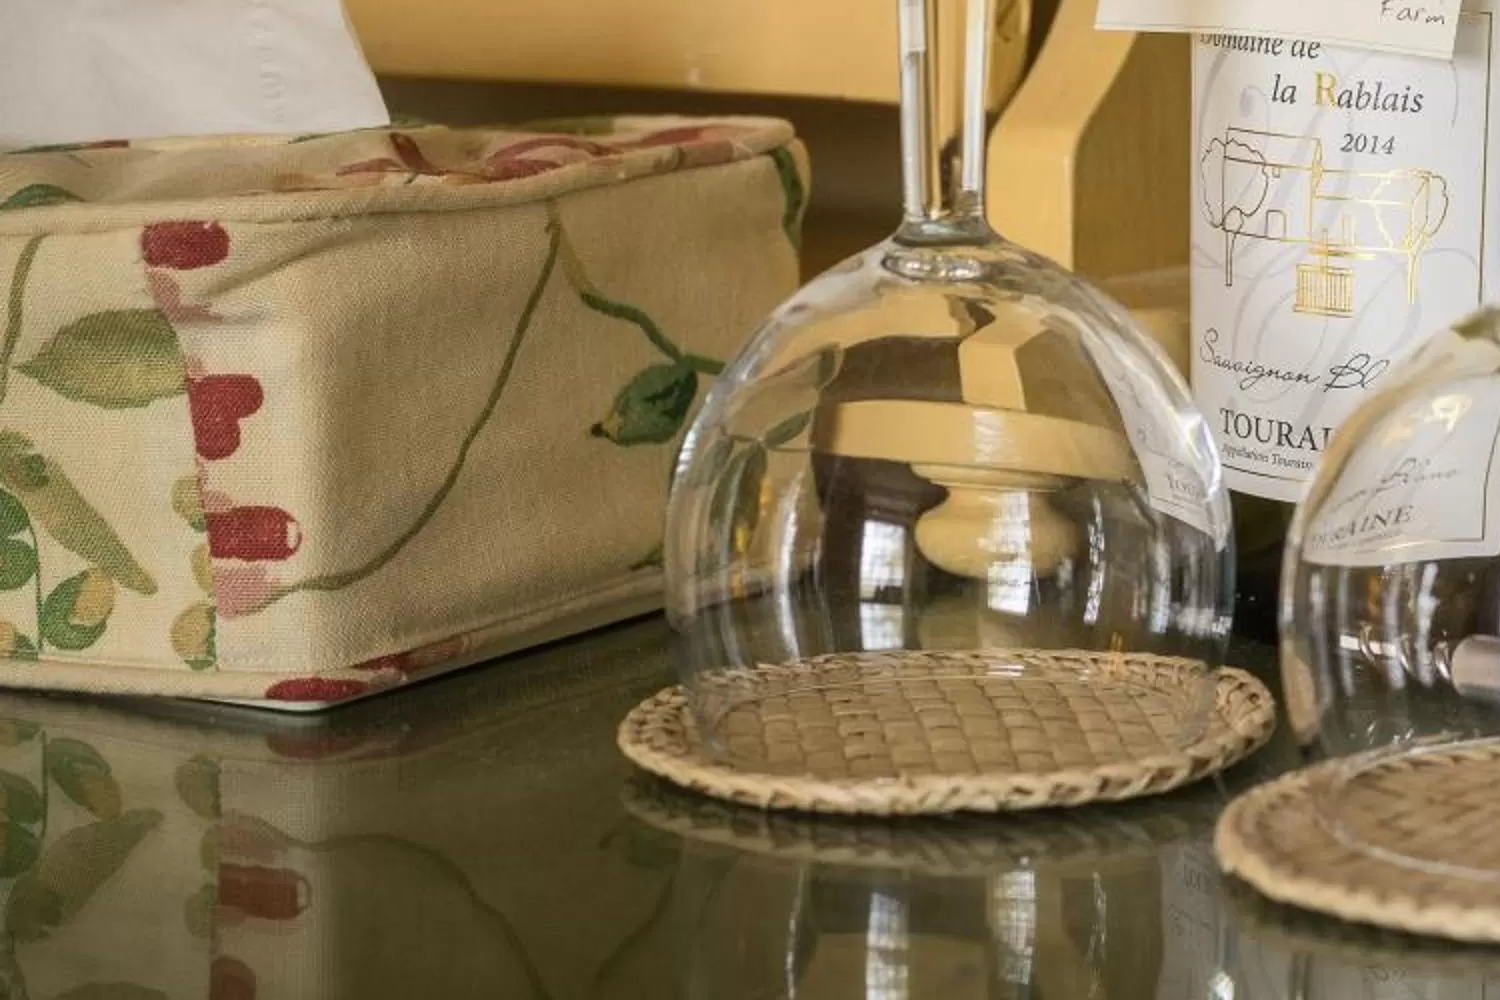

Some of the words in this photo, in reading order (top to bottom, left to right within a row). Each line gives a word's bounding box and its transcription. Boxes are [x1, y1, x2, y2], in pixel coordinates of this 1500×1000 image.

[1271, 74, 1297, 103] la
[1315, 71, 1424, 113] Rablais
[1340, 132, 1396, 154] 2014
[1220, 407, 1333, 452] TOURAI
